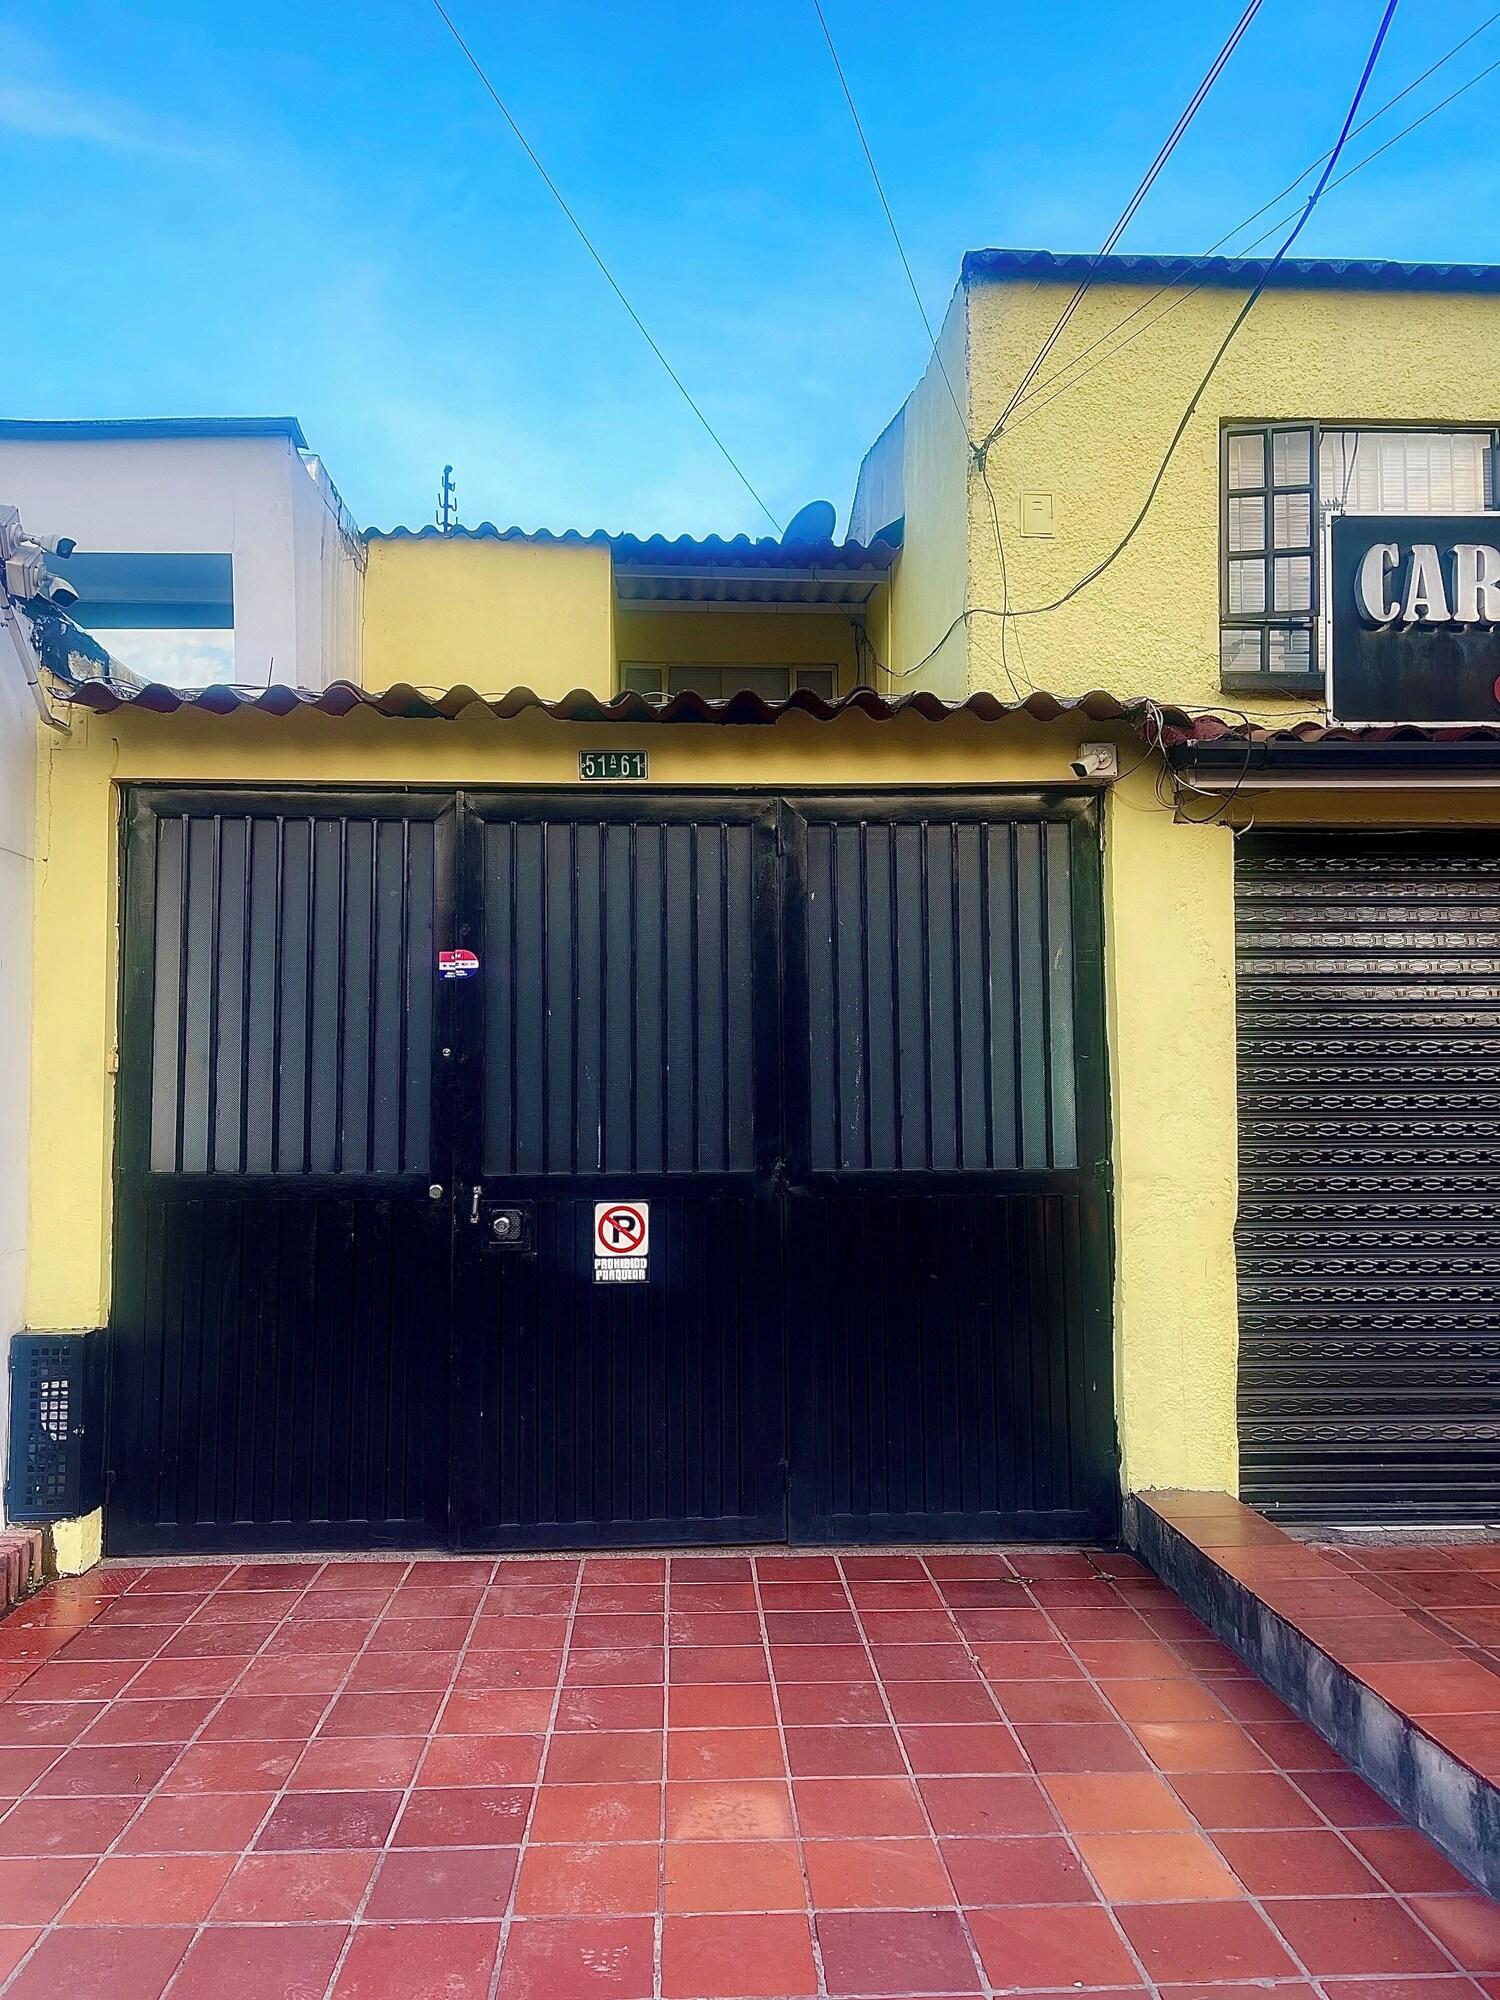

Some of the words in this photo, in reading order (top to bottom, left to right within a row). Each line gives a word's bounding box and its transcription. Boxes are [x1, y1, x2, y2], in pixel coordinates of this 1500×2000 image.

[1357, 542, 1500, 622] CAR
[612, 1215, 636, 1244] P
[594, 1257, 648, 1270] PROHIBIDO
[595, 1269, 646, 1281] PARQUEAR
